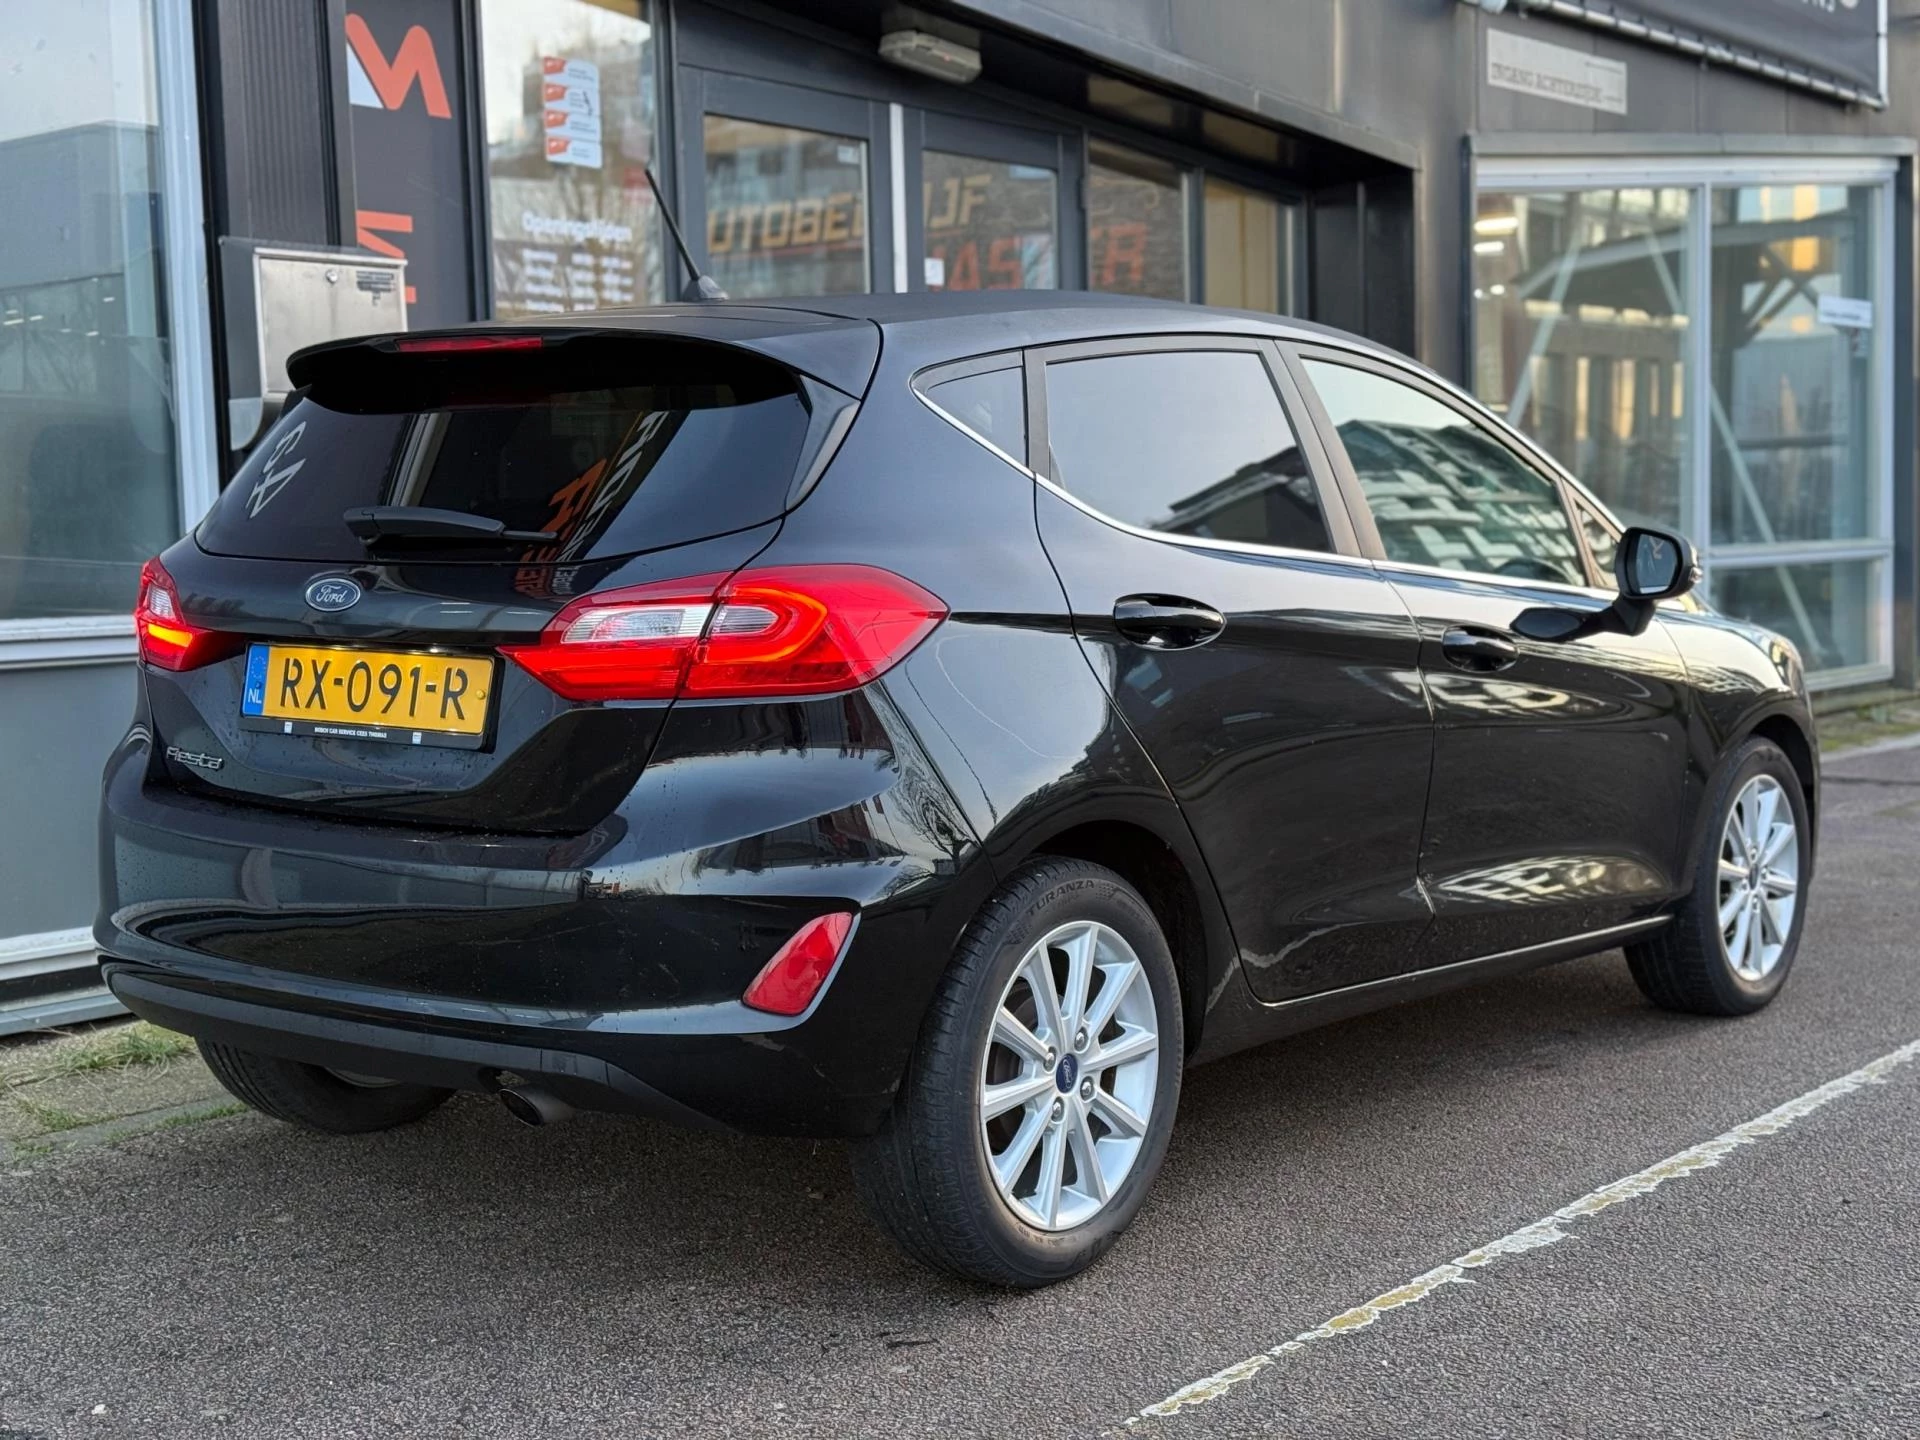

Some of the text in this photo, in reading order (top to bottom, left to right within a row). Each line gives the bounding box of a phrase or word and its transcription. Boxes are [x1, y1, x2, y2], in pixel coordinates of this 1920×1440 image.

[316, 584, 348, 603] Ford
[247, 687, 262, 705] NL
[280, 657, 469, 721] RX-091-R
[166, 746, 223, 770] Fiesta
[1026, 879, 1095, 916] TURANZA
